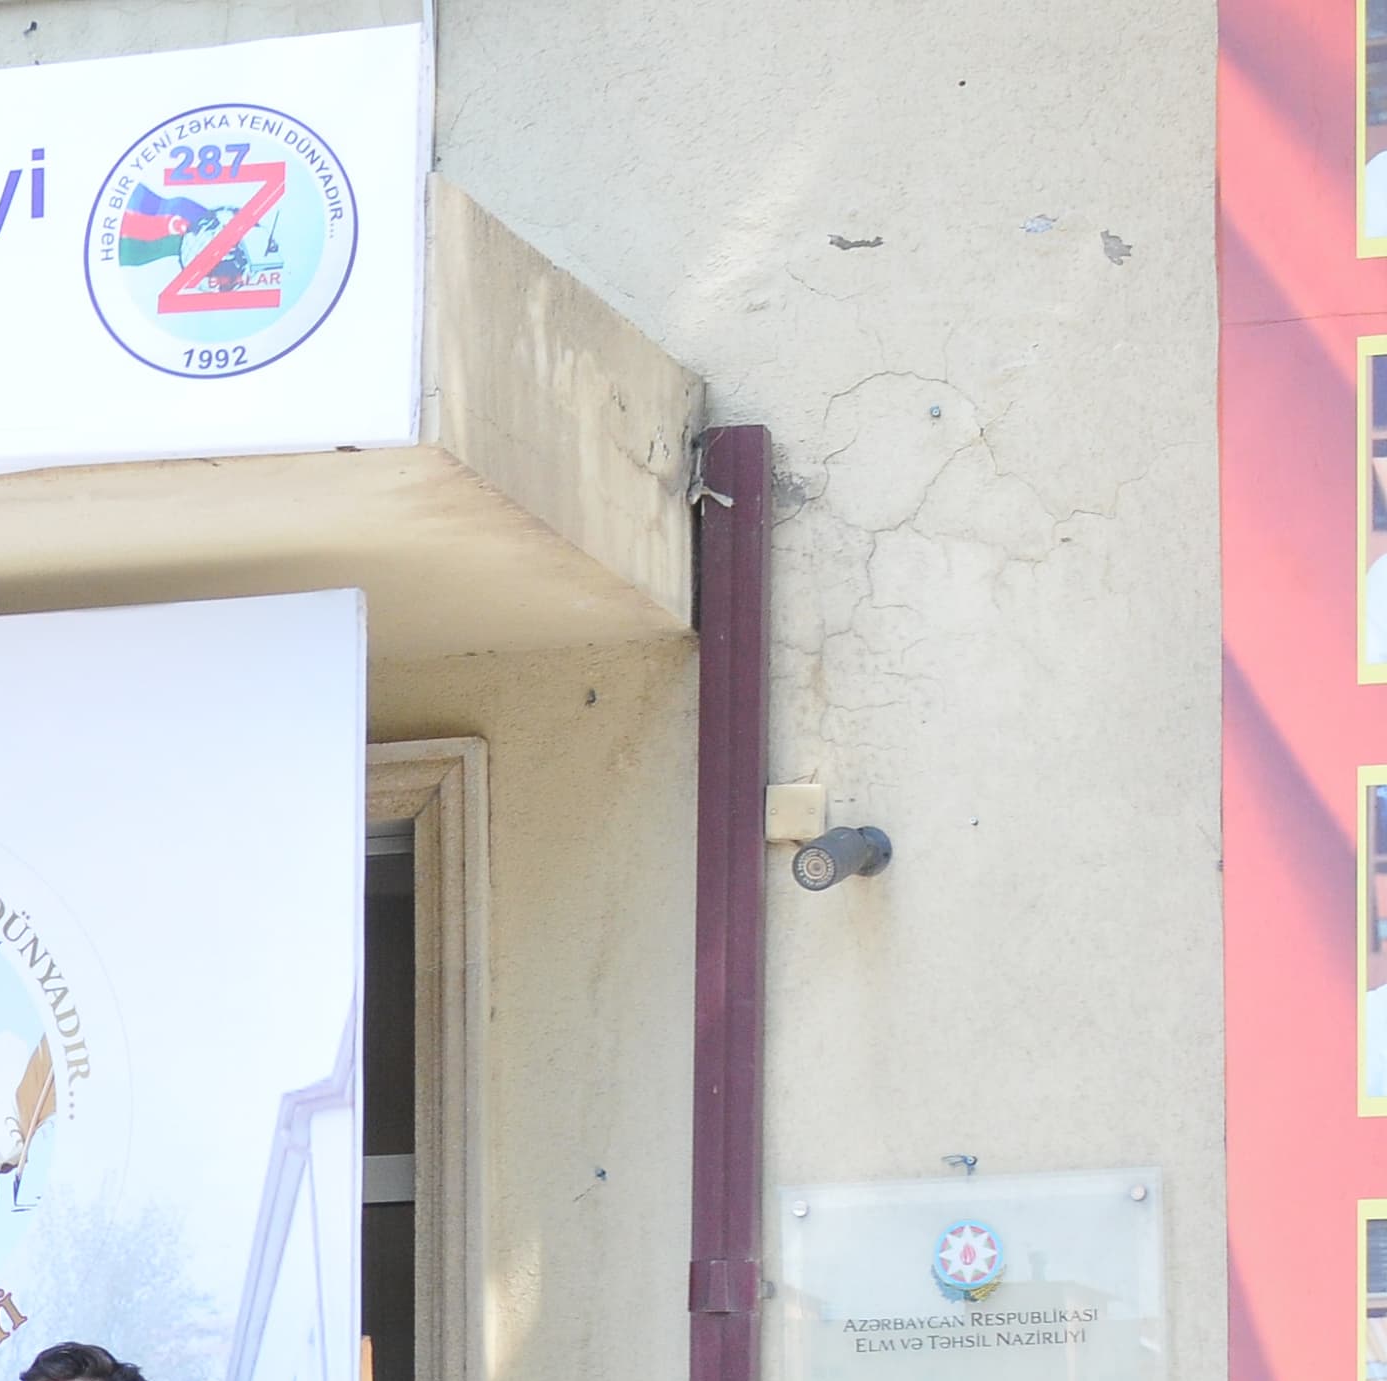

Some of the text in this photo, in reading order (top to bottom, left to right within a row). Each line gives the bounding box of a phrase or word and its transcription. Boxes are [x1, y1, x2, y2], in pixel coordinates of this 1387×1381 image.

[175, 114, 230, 140] ZƏKA
[169, 143, 250, 181] 287
[183, 345, 248, 369] 1992
[843, 1307, 1099, 1333] AZƏRBAYCAN RESPUBLİKASI
[855, 1337, 895, 1353] ELM
[900, 1335, 924, 1350] VƏ
[927, 1331, 992, 1350] TƏHSİL
